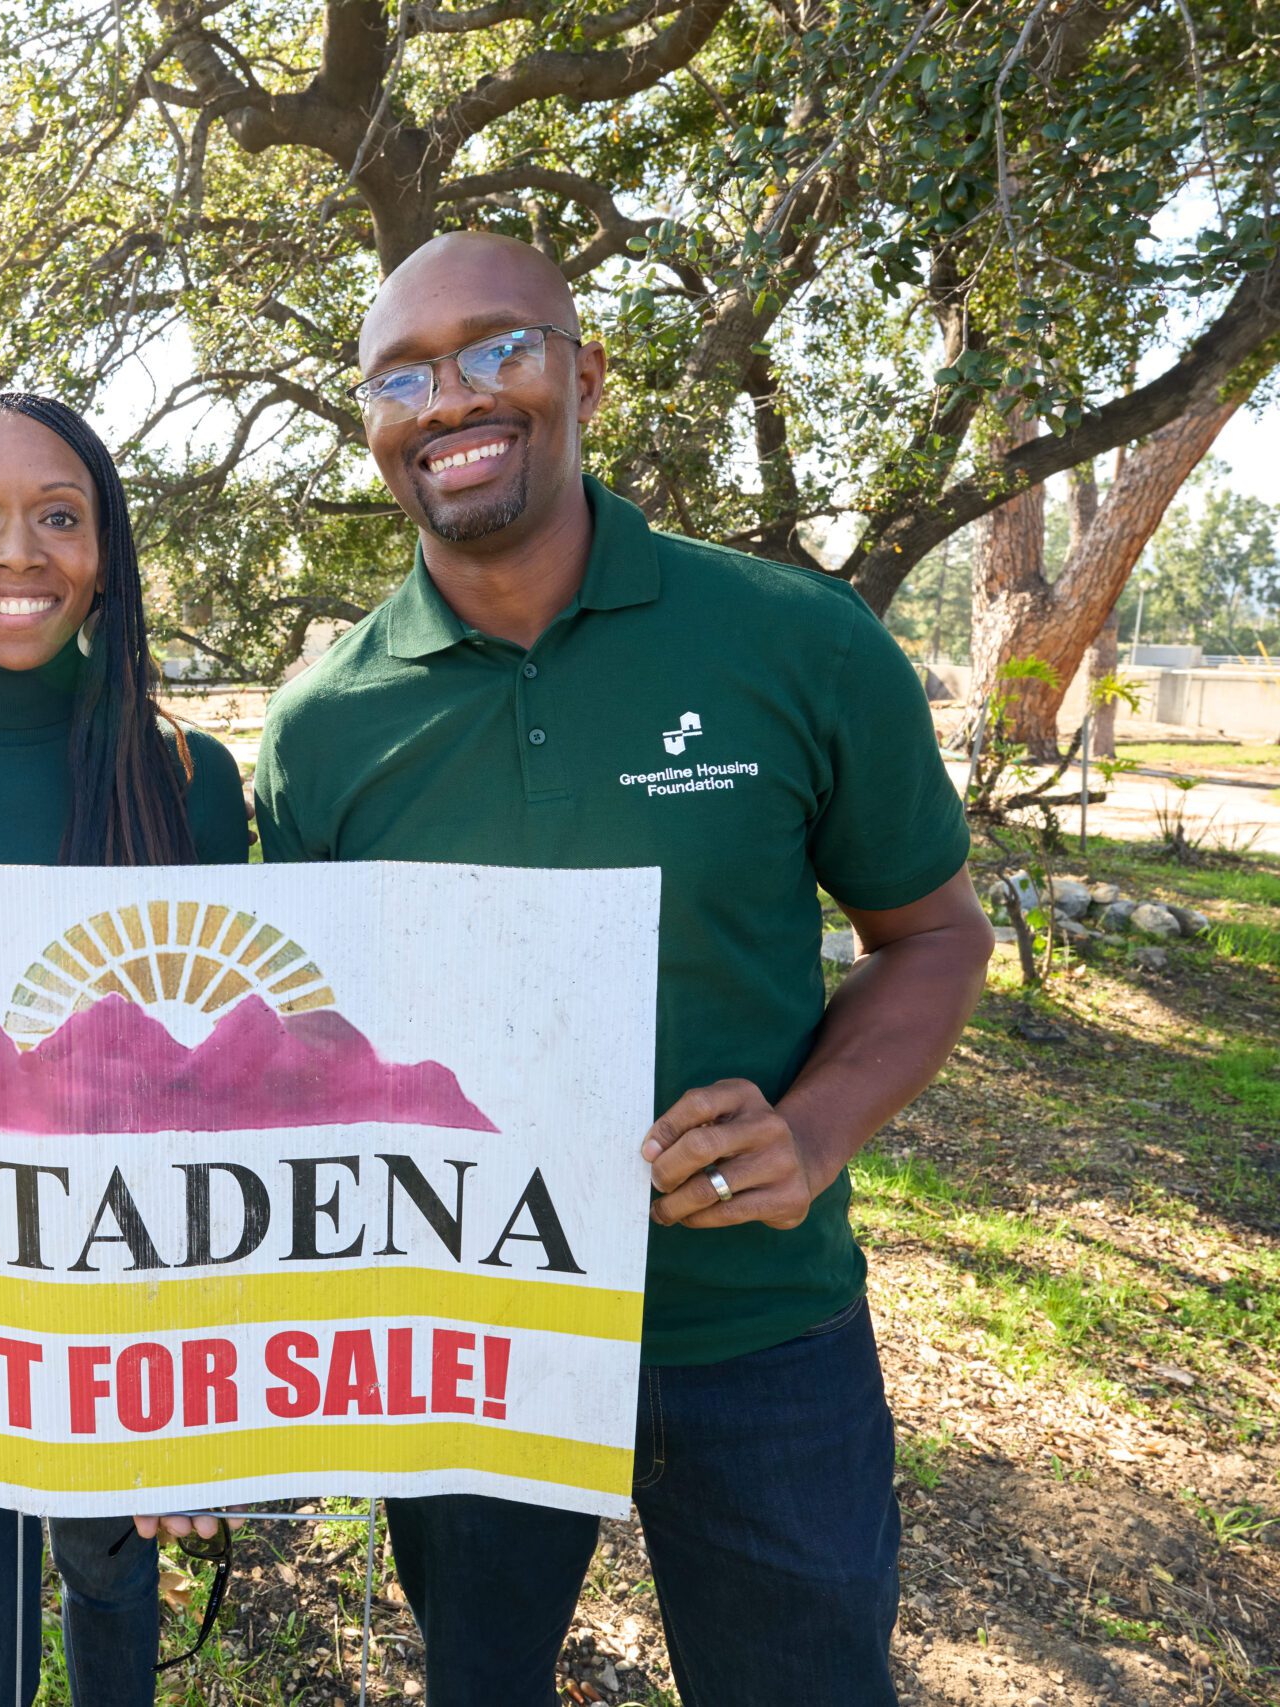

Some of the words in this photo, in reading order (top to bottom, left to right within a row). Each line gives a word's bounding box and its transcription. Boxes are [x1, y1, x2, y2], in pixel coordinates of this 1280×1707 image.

[620, 768, 693, 785] Greenline
[697, 761, 758, 776] Housing
[648, 777, 734, 796] Foundation
[67, 1337, 238, 1433] FOR
[265, 1327, 511, 1421] SALE!
